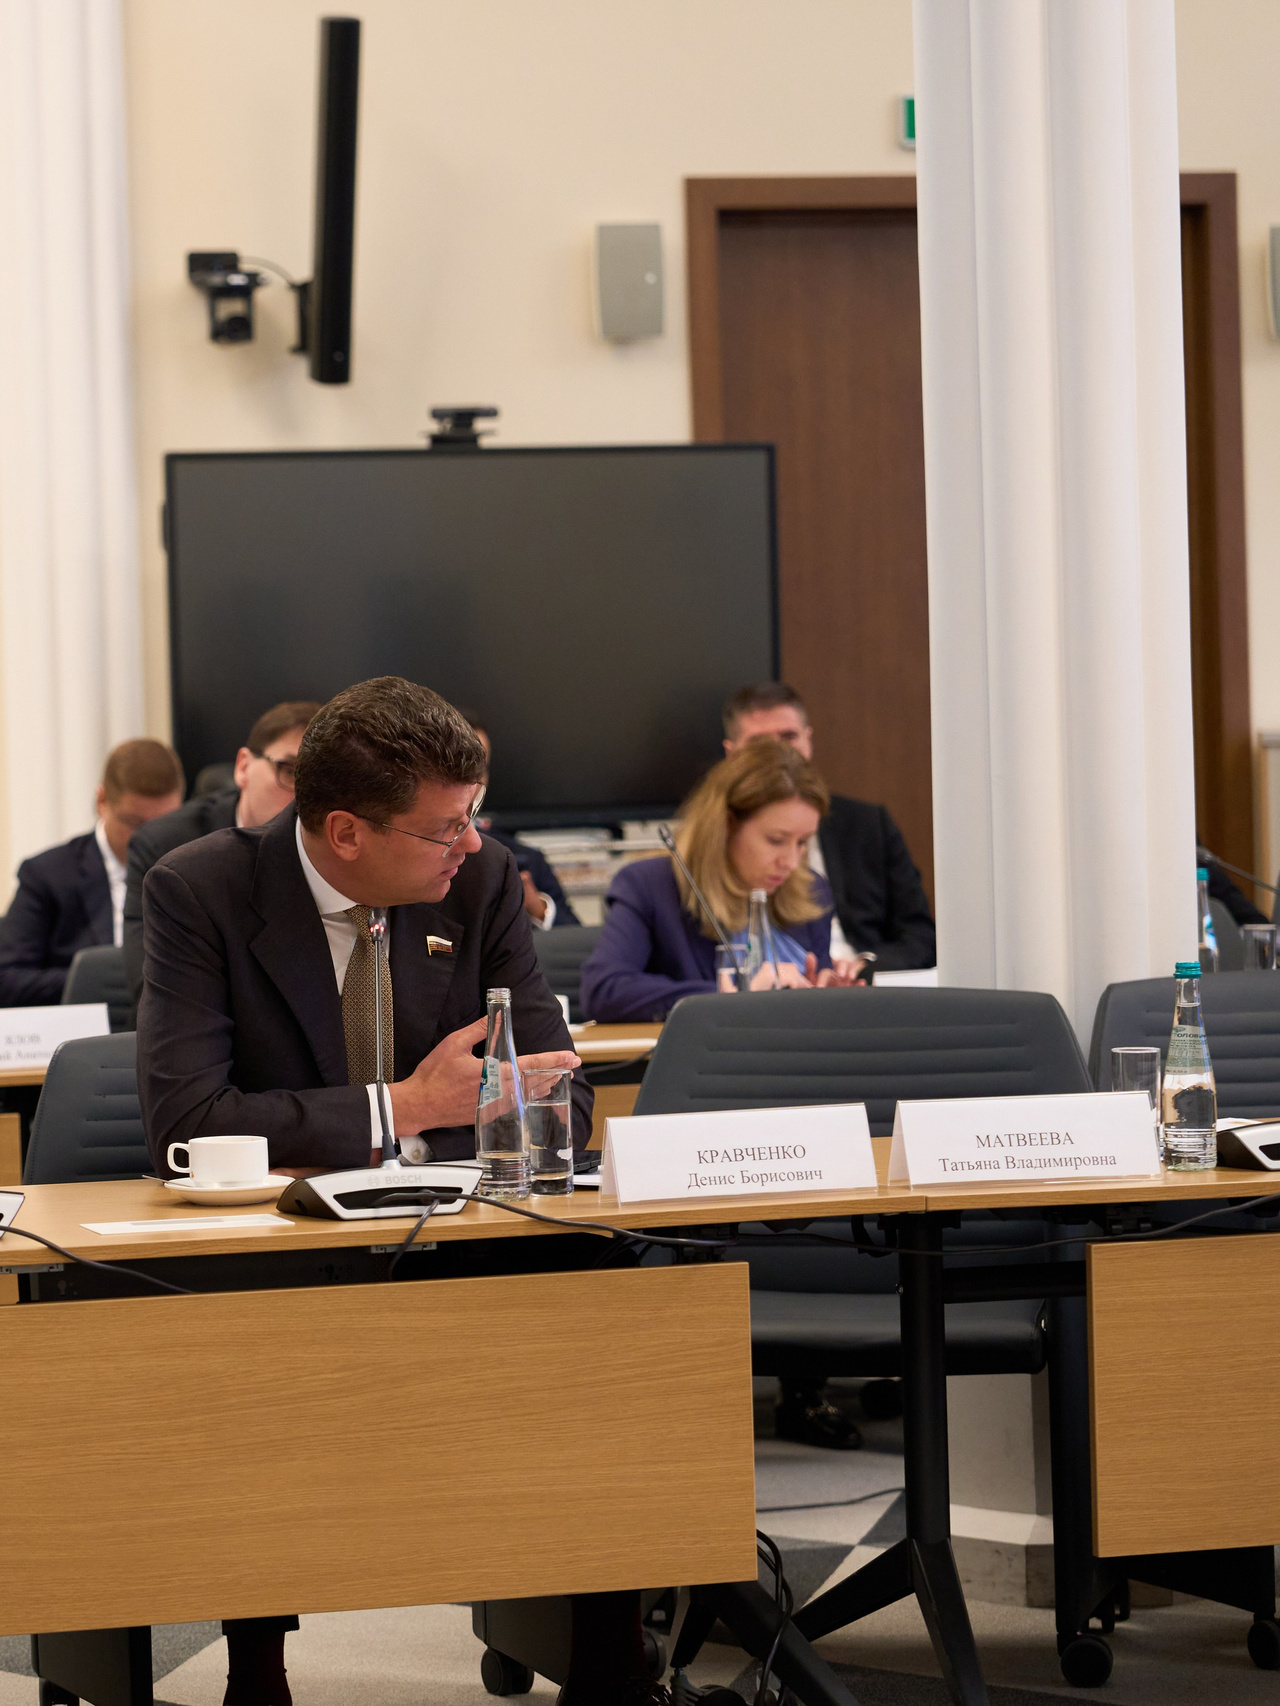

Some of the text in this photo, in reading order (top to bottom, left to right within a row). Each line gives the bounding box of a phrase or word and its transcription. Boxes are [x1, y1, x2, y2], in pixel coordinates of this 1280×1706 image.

[975, 1131, 1075, 1148] МАТВЕЕВА
[697, 1144, 807, 1164] КРАВЧЕНКО
[938, 1154, 1117, 1172] Татьяна Владимировна
[384, 1174, 422, 1185] BOSCH
[687, 1169, 823, 1189] Денис Борисович
